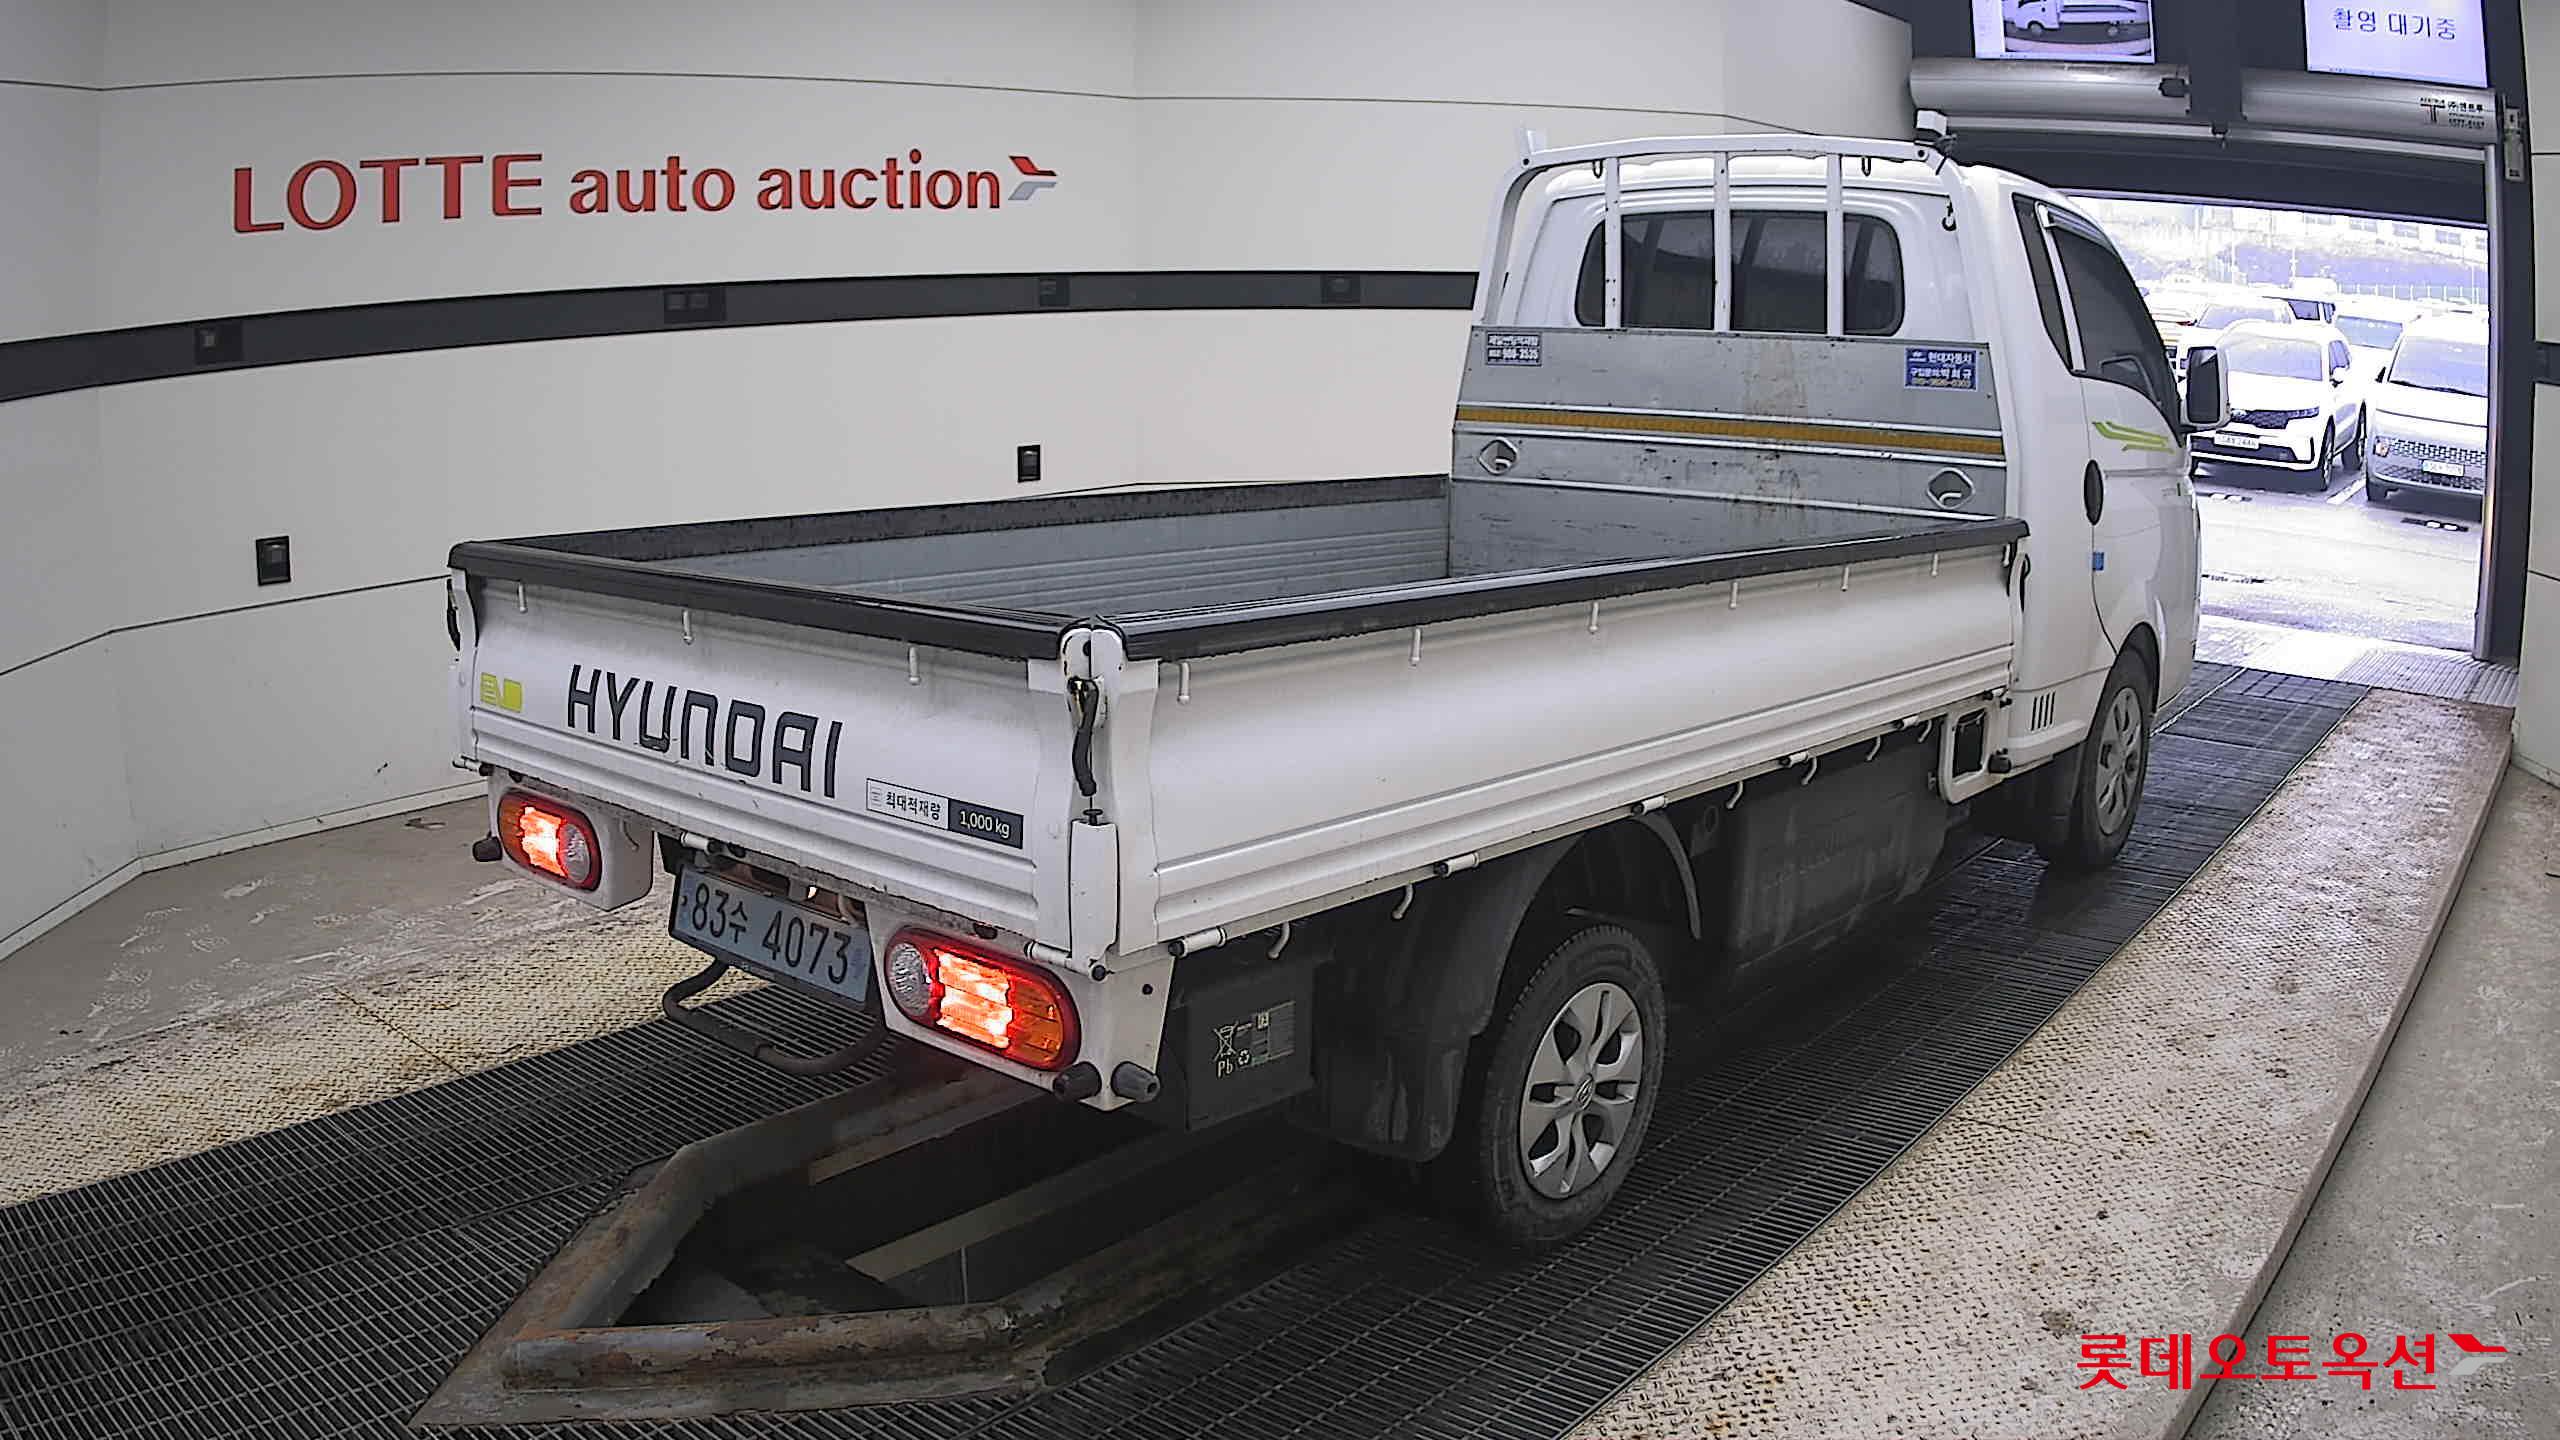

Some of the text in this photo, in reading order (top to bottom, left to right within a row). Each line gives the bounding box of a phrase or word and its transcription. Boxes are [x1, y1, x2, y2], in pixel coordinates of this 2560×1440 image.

[2334, 8, 2456, 40] 촬영 대기중
[234, 148, 1001, 233] LOTTE auto auction
[567, 664, 842, 799] HYUNDAI
[886, 791, 941, 821] 최대적재량
[960, 811, 1011, 839] 1,000 kg
[692, 882, 852, 984] 83수 4073
[1218, 1058, 1234, 1078] Pb
